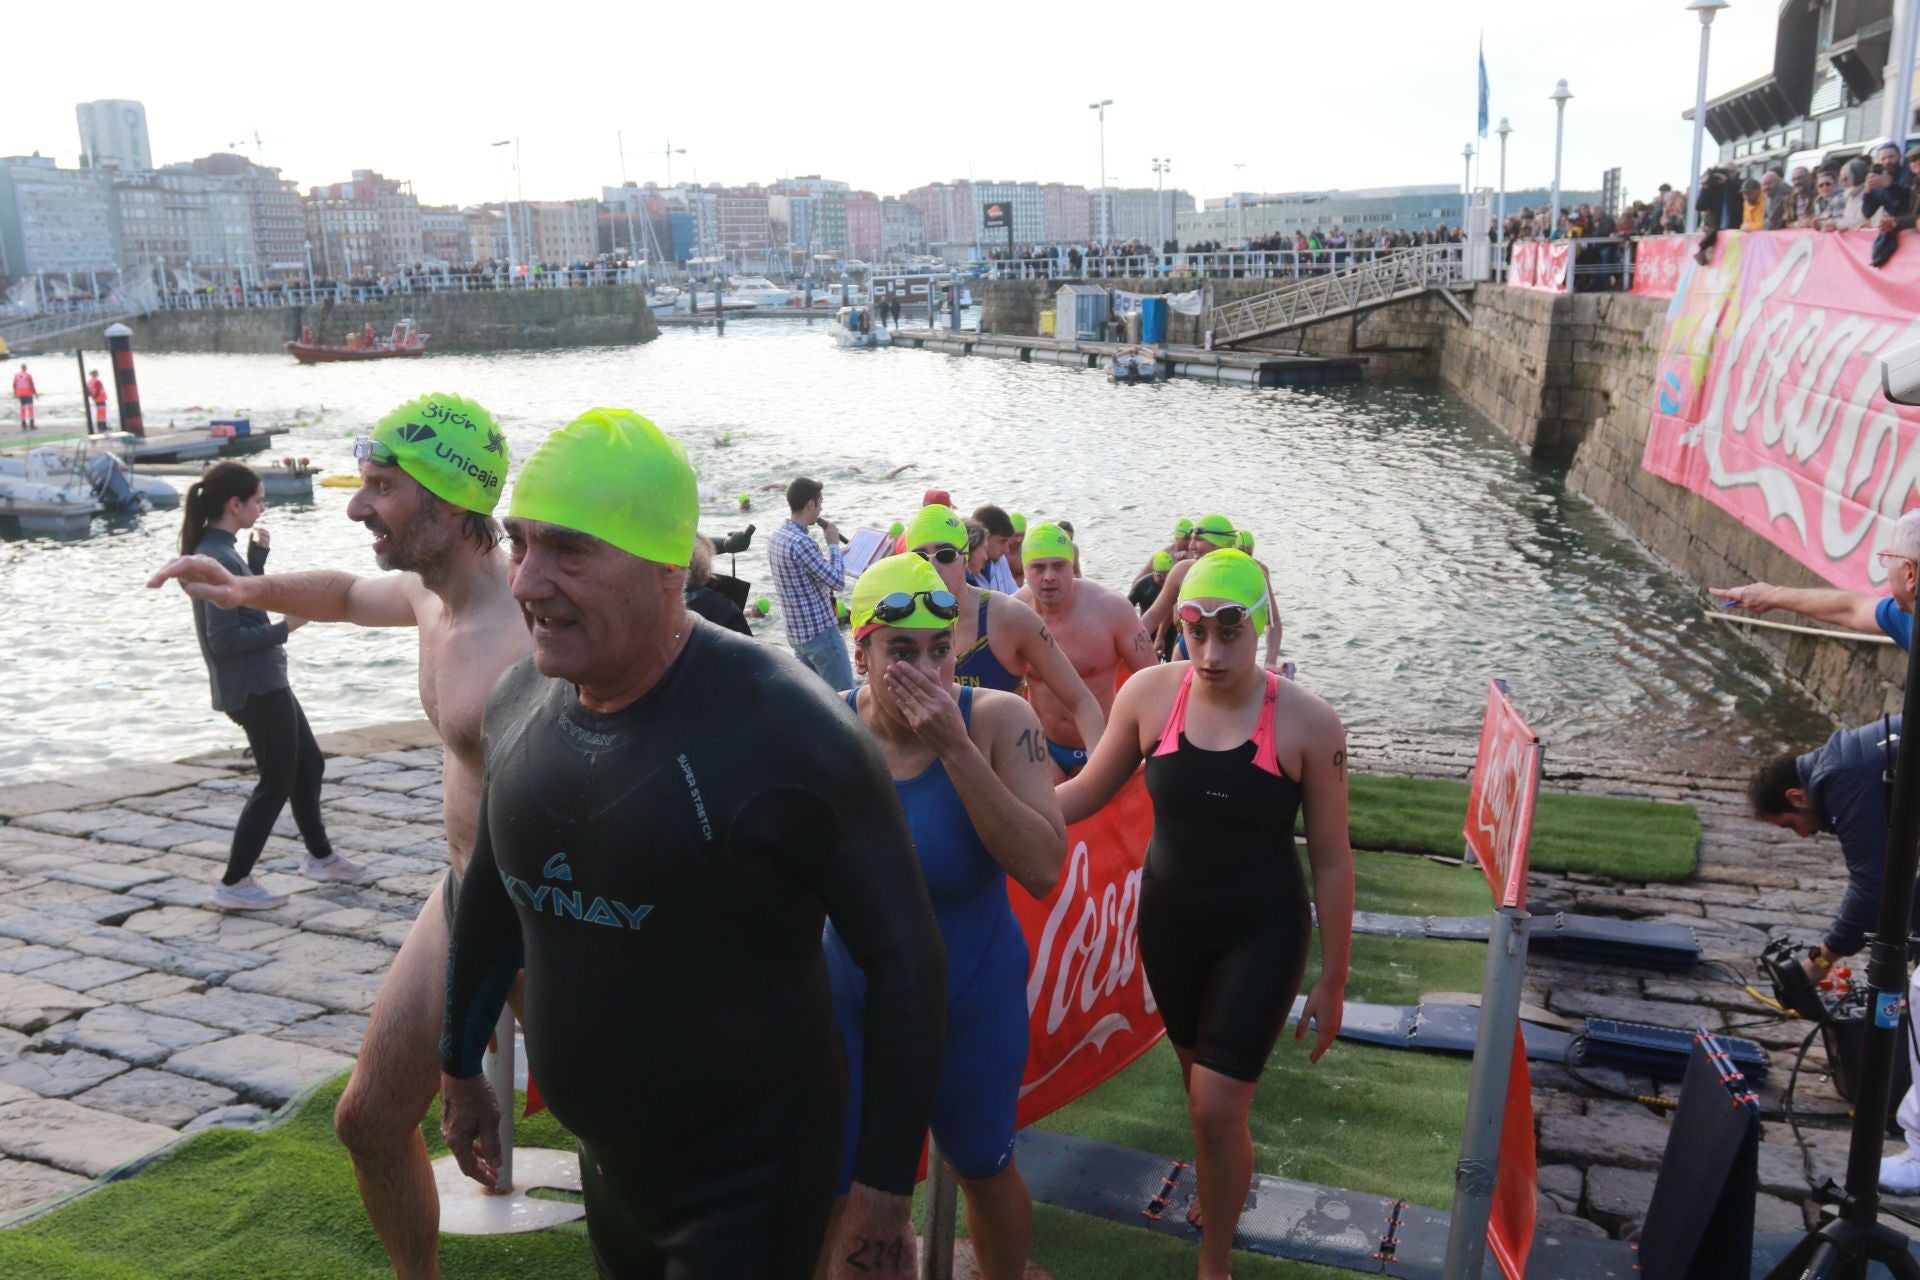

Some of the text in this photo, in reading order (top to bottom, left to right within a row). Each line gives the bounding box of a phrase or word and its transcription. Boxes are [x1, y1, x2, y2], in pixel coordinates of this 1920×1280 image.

[434, 441, 499, 489] Unicaja
[1016, 728, 1047, 763] 16
[677, 753, 715, 842] SUPER STRETCH
